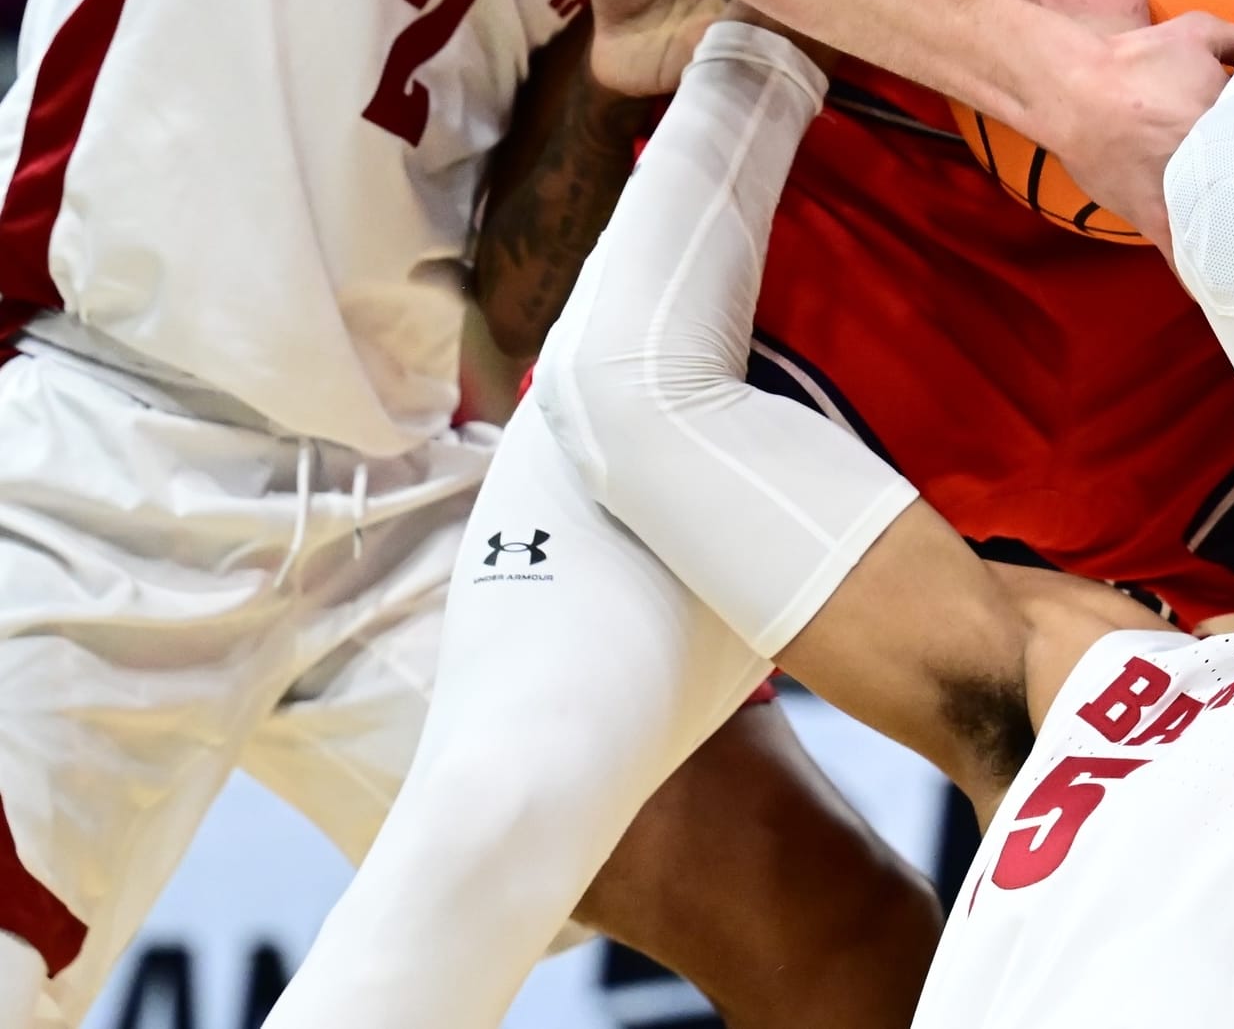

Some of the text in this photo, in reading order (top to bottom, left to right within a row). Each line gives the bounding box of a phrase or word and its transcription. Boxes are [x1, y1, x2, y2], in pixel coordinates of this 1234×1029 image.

[473, 574, 554, 584] UNDER ARMOUR
[967, 755, 1154, 919] 5
